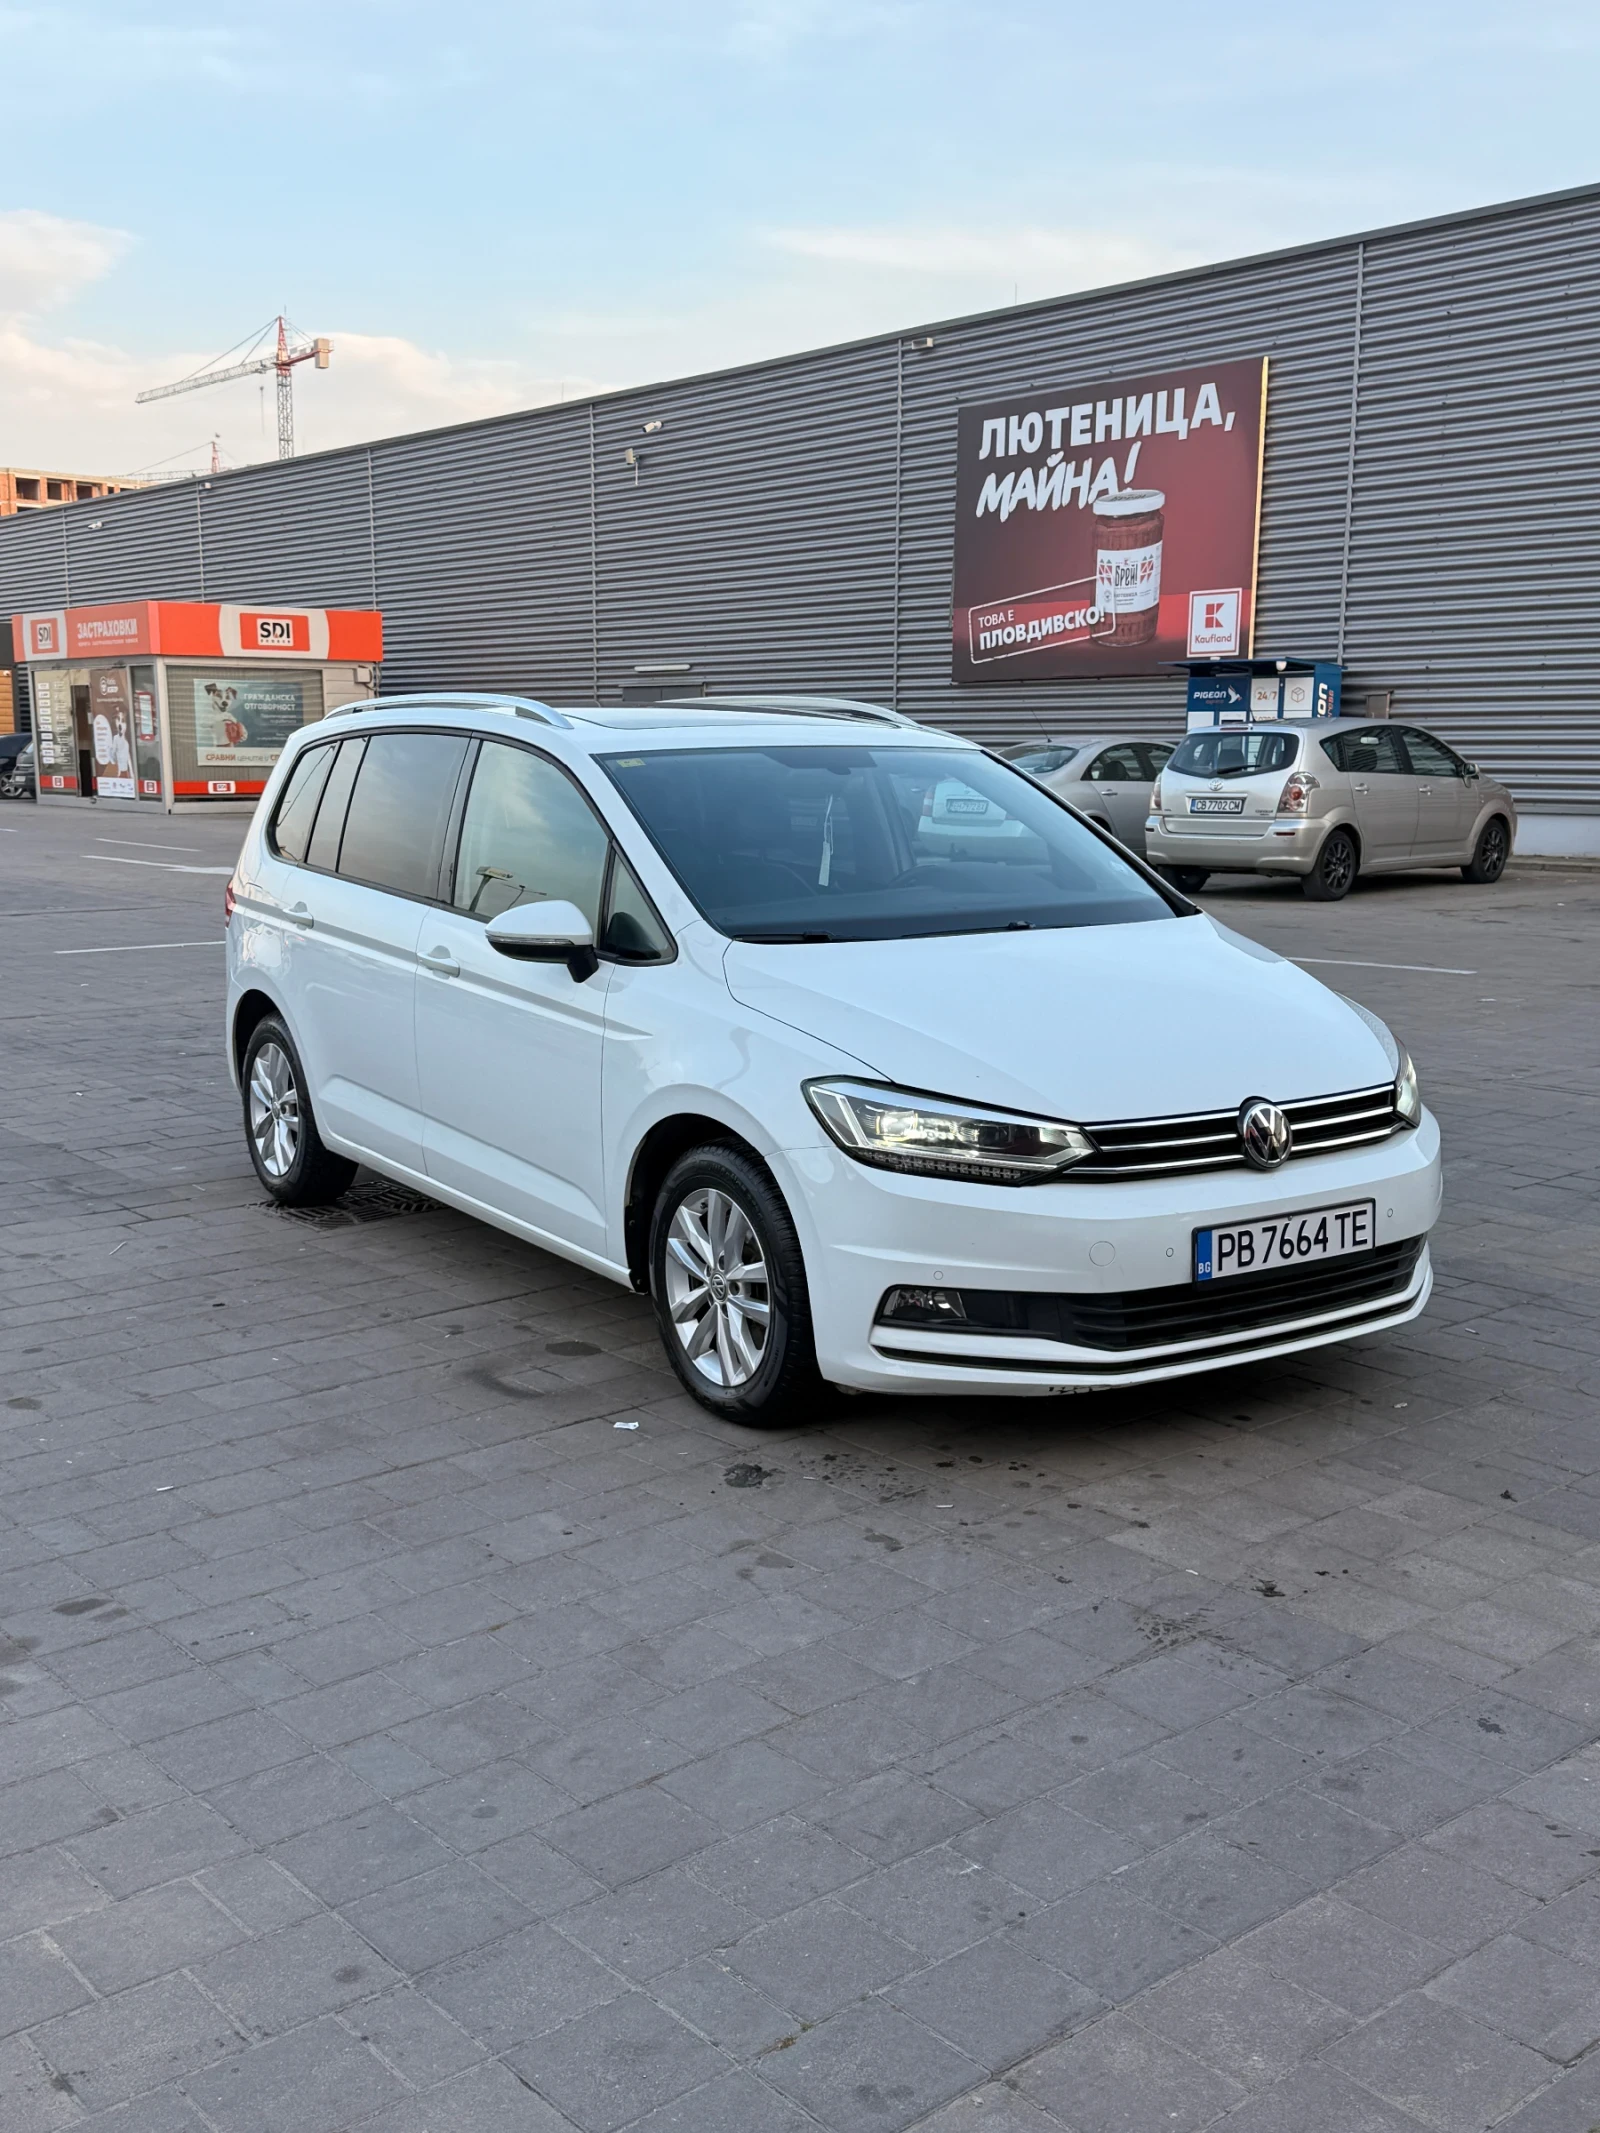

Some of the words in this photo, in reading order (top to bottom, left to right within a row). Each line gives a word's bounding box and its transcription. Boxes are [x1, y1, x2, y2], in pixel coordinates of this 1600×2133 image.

[978, 382, 1236, 460] ЛЮТЕНИЦА,
[976, 440, 1142, 523] МАЙНА!
[978, 612, 1006, 628] ТОВА
[1008, 609, 1015, 622] Е
[980, 605, 1106, 650] ПЛОВДИВСКО!
[38, 626, 51, 643] SDI
[77, 618, 138, 639] ЗАСТРАХОВКИ
[260, 621, 291, 639] SDI
[1194, 633, 1232, 644] Kaufland
[1257, 690, 1277, 701] 24/7
[1208, 801, 1227, 811] 7702
[1217, 1230, 1255, 1272] PB
[1261, 1216, 1329, 1264] 7664
[1334, 1209, 1368, 1250] TE
[1198, 1261, 1211, 1275] BG
